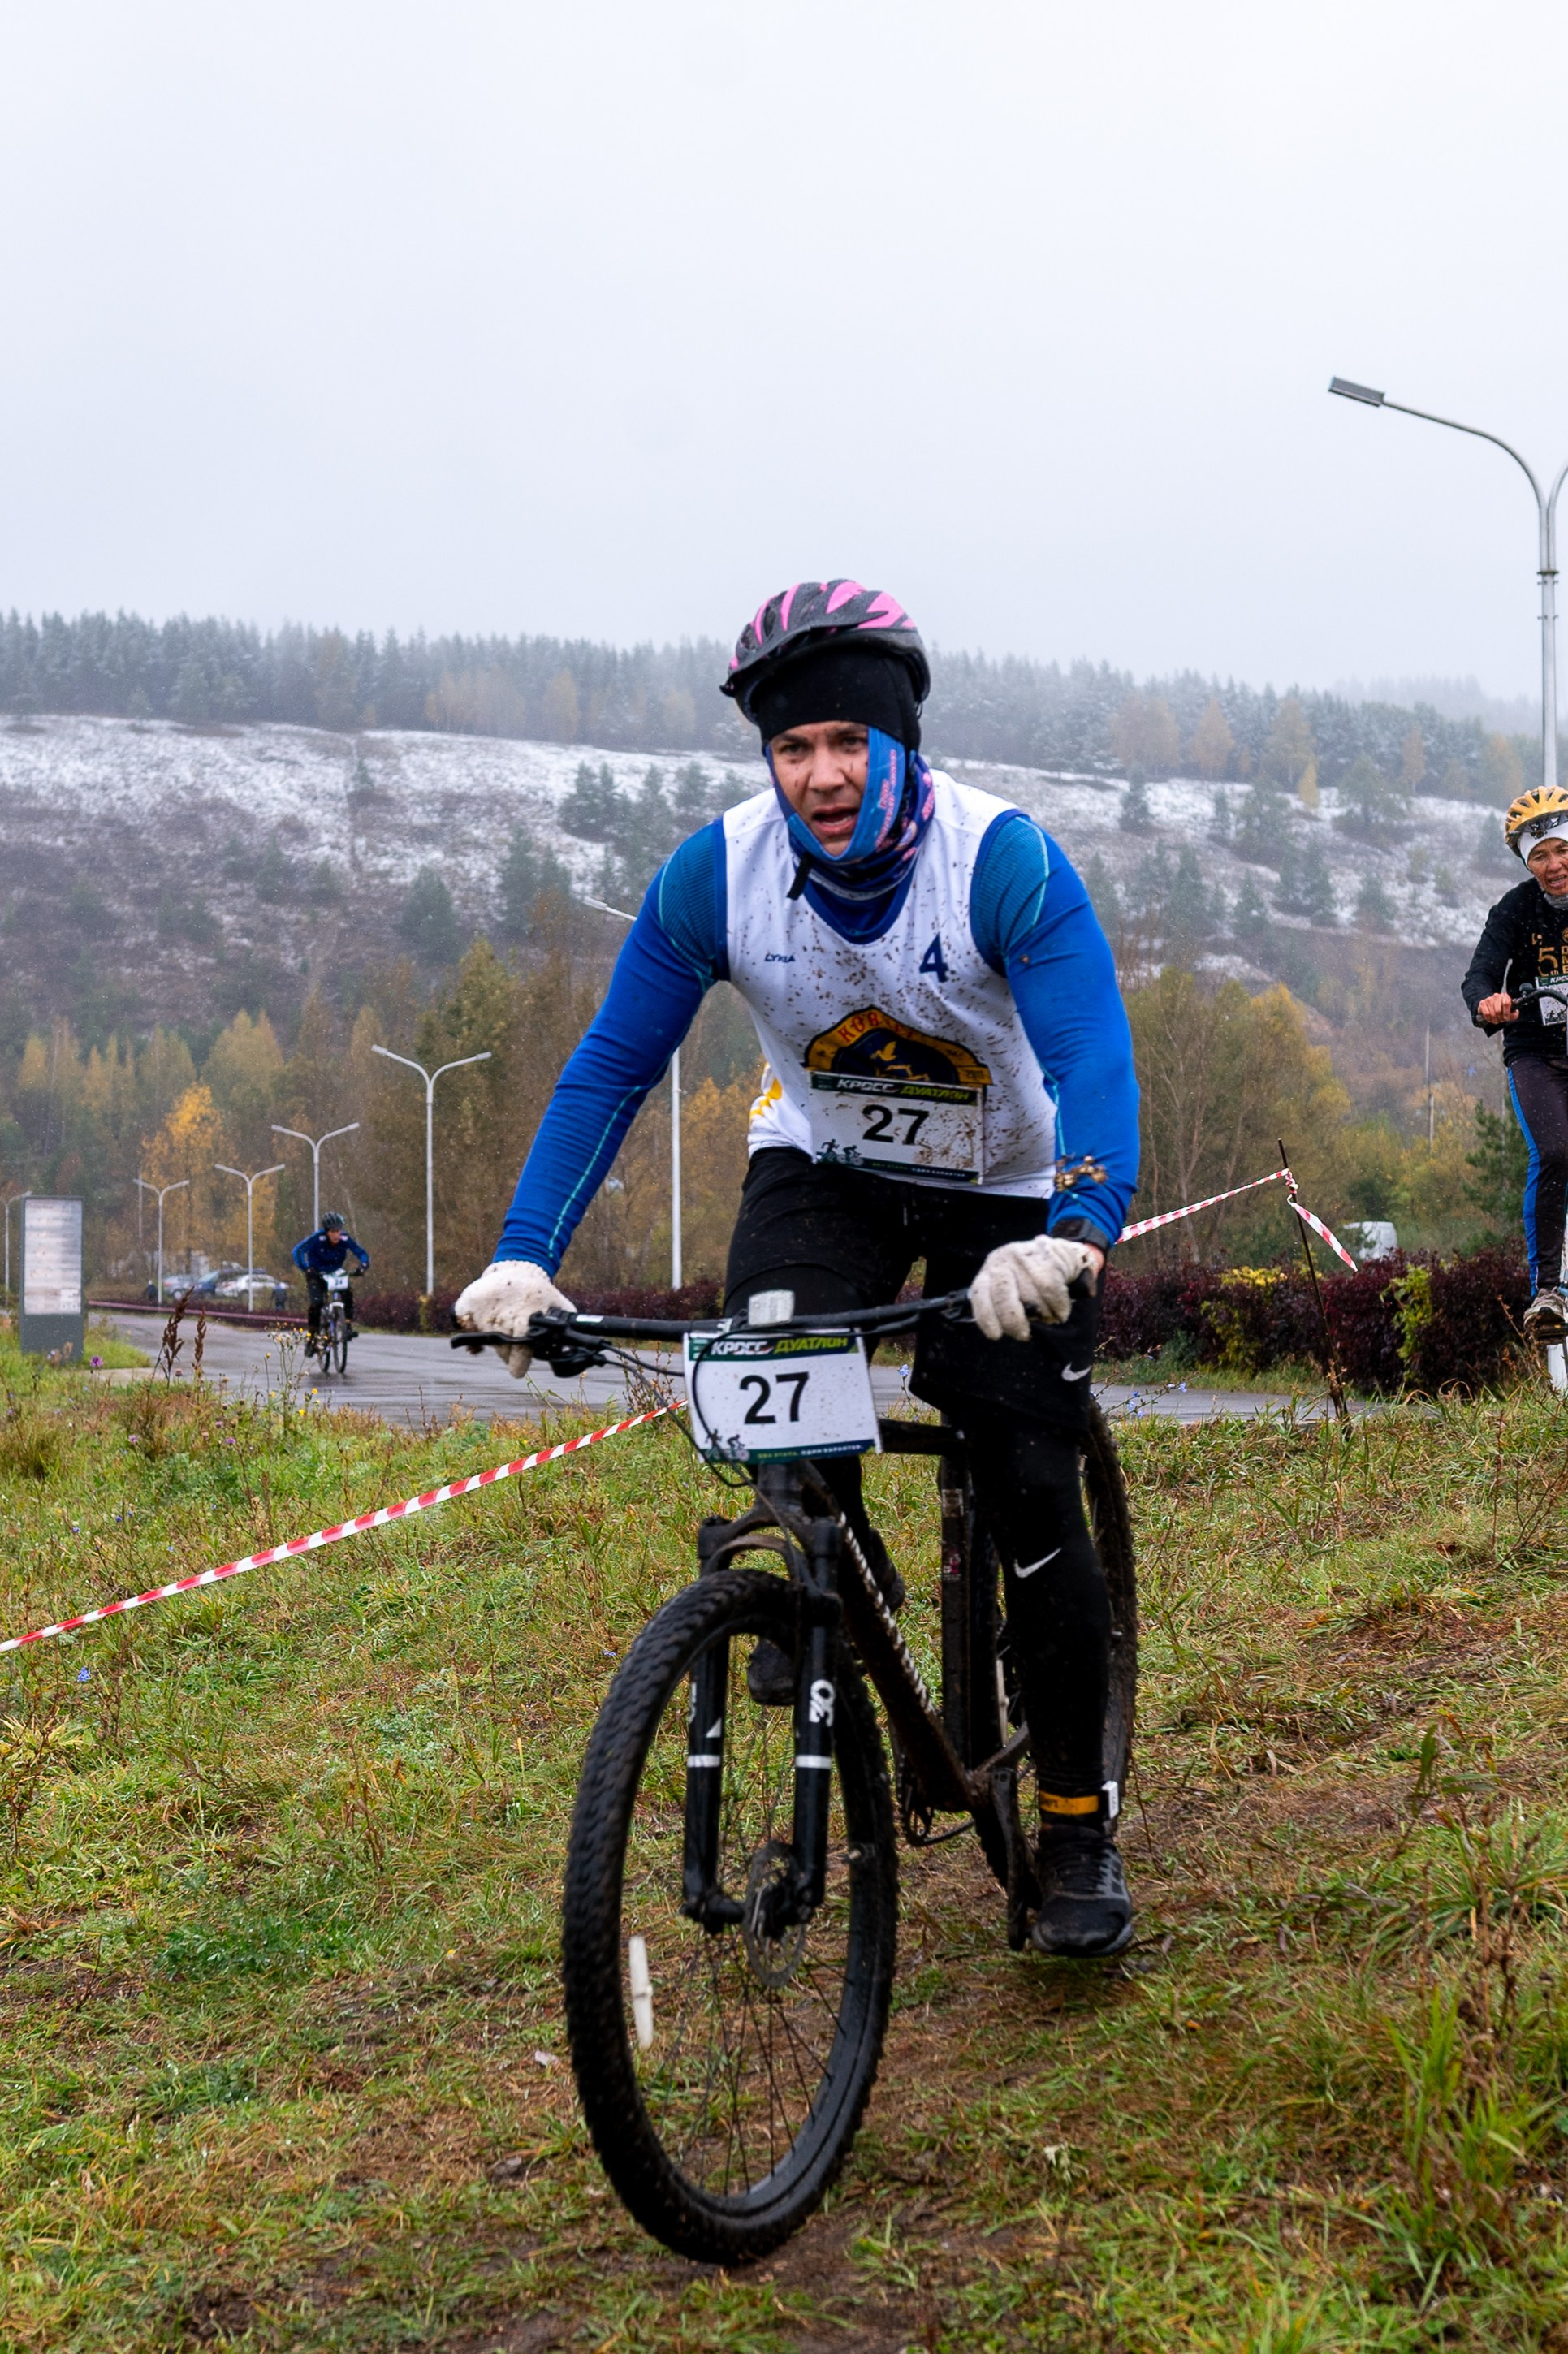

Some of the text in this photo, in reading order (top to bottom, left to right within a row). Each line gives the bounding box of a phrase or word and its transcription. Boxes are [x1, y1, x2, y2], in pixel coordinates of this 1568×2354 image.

[919, 931, 949, 983] 4
[837, 1078, 894, 1093] КРОСС
[901, 1085, 970, 1100] ДУАТЛОН
[862, 1104, 930, 1145] 27
[711, 1341, 767, 1356] КРОСС
[774, 1337, 849, 1354] ДУАТЛОН
[739, 1371, 809, 1425] 27
